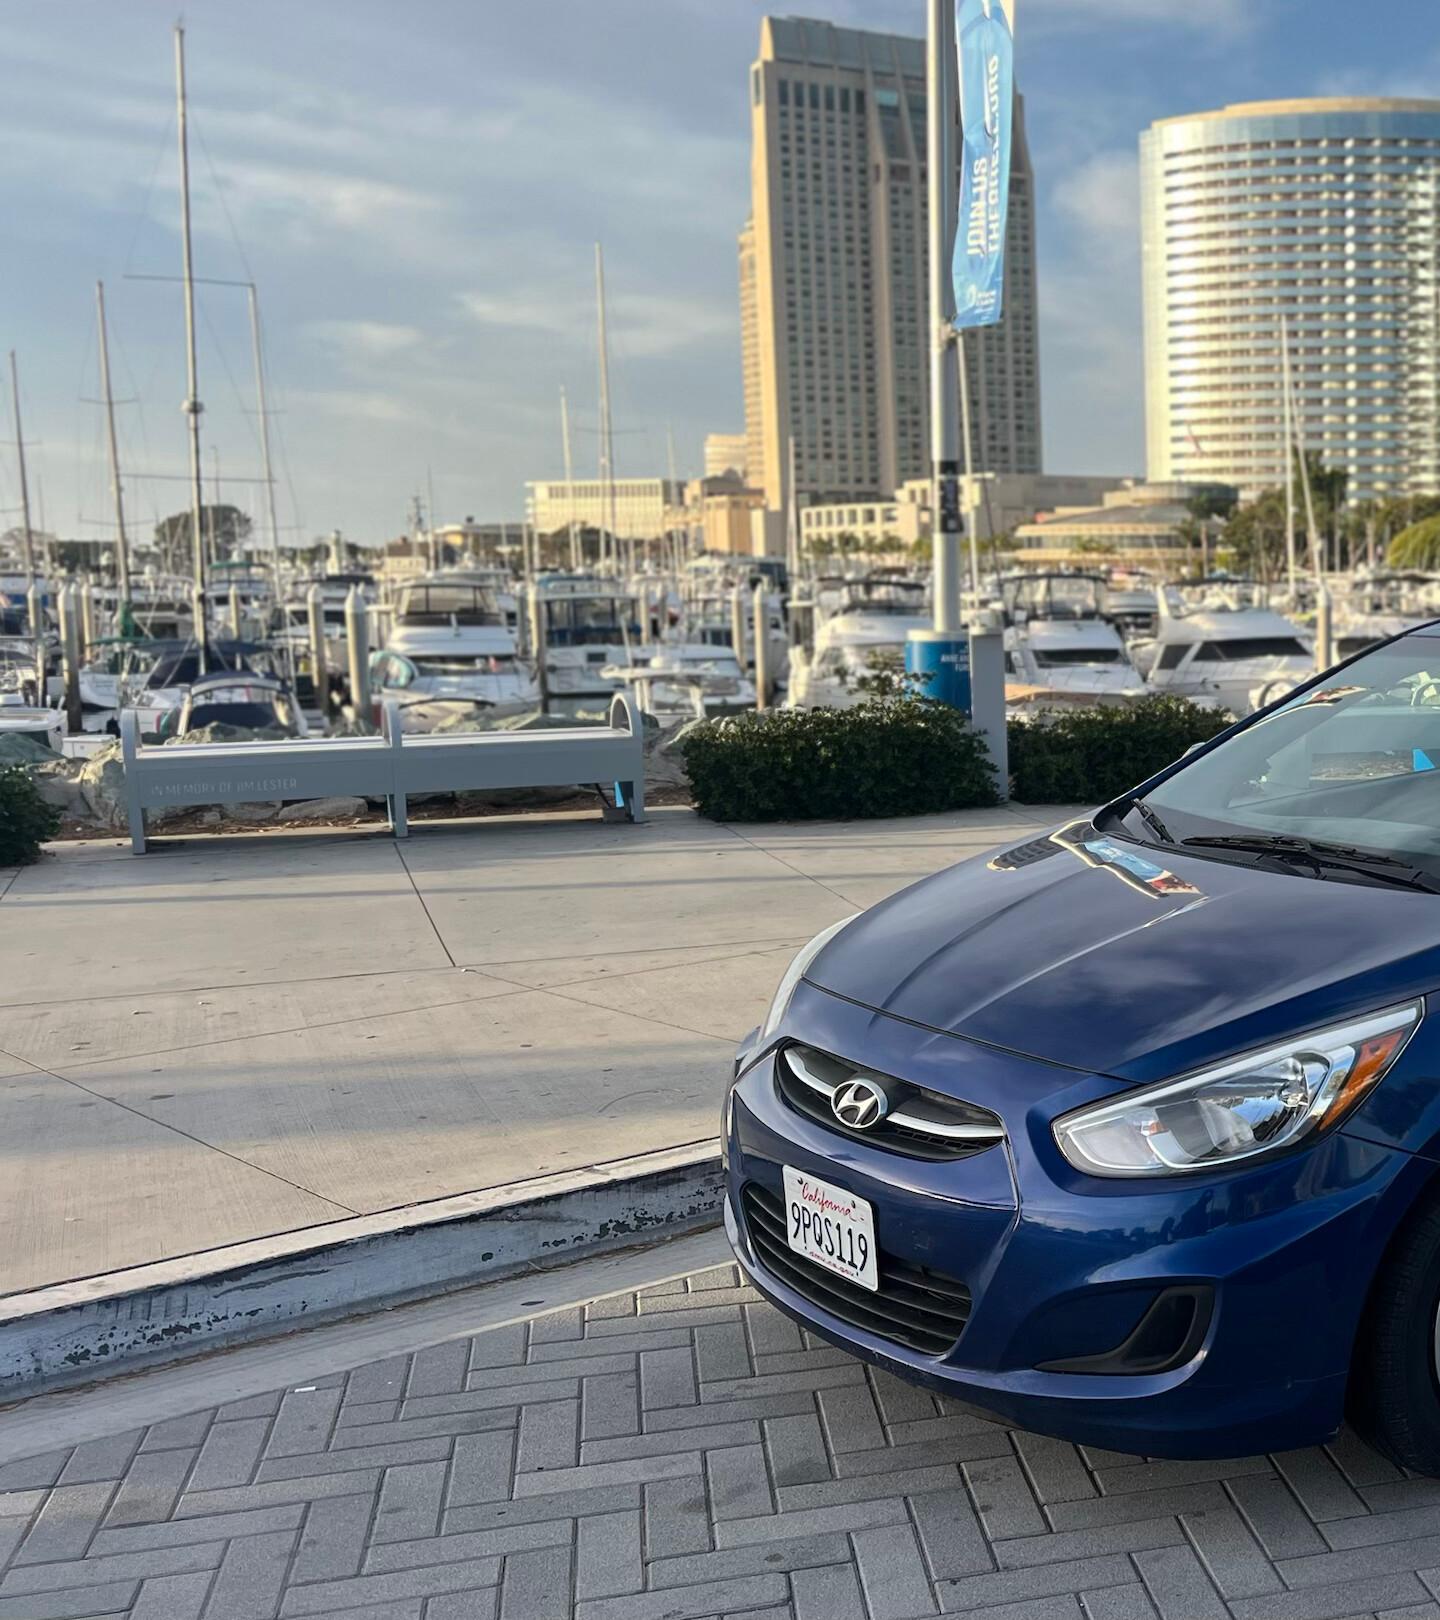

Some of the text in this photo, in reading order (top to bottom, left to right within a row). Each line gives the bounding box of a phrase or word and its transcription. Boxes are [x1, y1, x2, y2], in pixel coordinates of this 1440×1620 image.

[967, 157, 988, 257] JOIN US
[165, 783, 215, 795] MEMORY
[219, 781, 232, 793] OF
[257, 777, 297, 792] LESTER
[802, 1182, 857, 1222] California
[791, 1201, 868, 1272] 9PQS119
